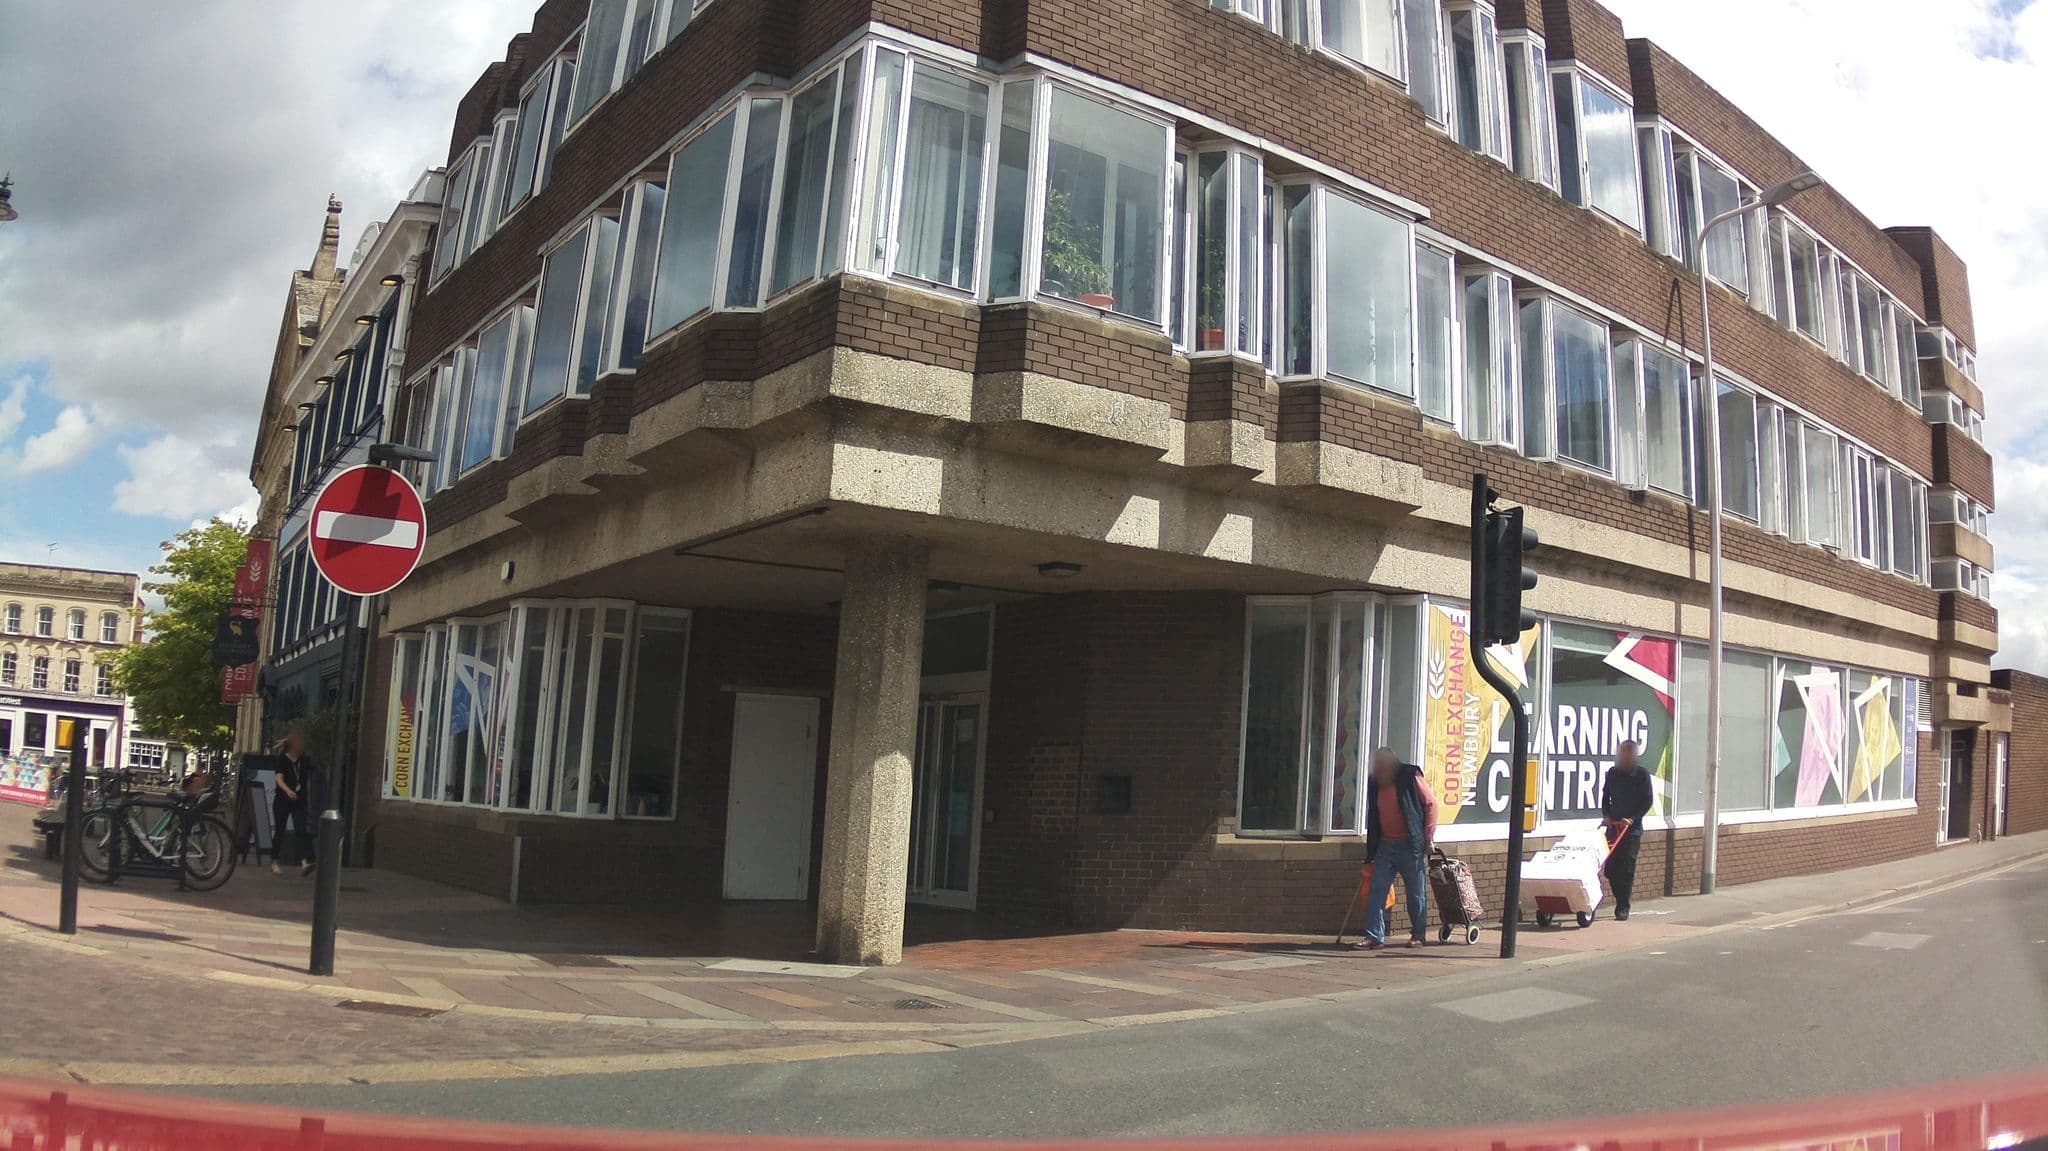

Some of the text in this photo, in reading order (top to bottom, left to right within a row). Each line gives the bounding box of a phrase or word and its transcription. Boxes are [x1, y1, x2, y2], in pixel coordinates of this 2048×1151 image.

[1444, 614, 1466, 806] CORN EXCHANGE
[1461, 692, 1481, 806] NEWBURY
[395, 756, 409, 788] CORN
